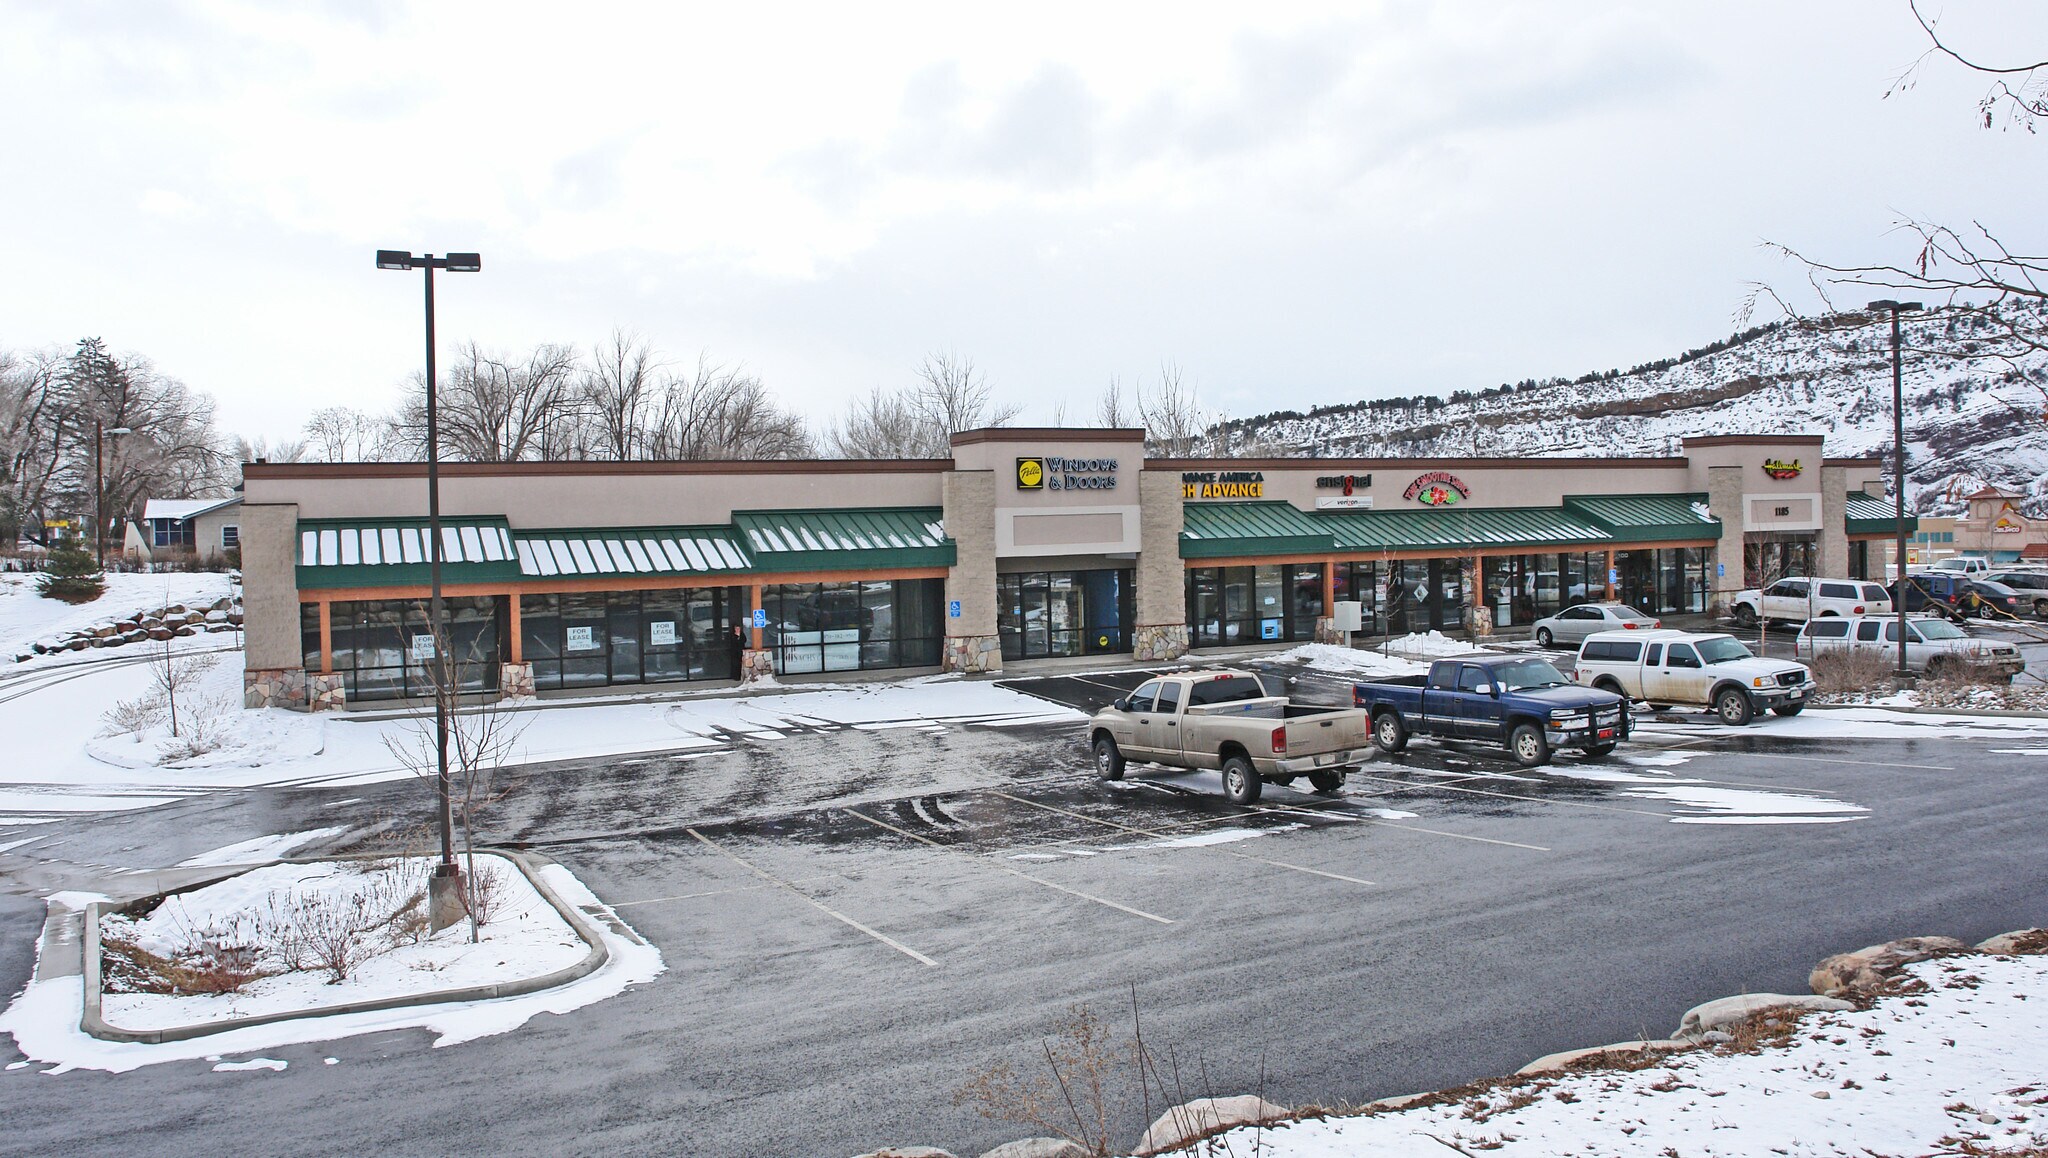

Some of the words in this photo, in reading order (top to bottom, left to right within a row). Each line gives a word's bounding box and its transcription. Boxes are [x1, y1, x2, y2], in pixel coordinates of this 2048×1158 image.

[1045, 457, 1118, 472] WINDOWS
[1049, 475, 1061, 490] &
[1064, 474, 1117, 490] DOORS
[1218, 472, 1264, 482] AMERICA
[1202, 483, 1263, 498] ADVANCE
[1775, 506, 1789, 516] 1185
